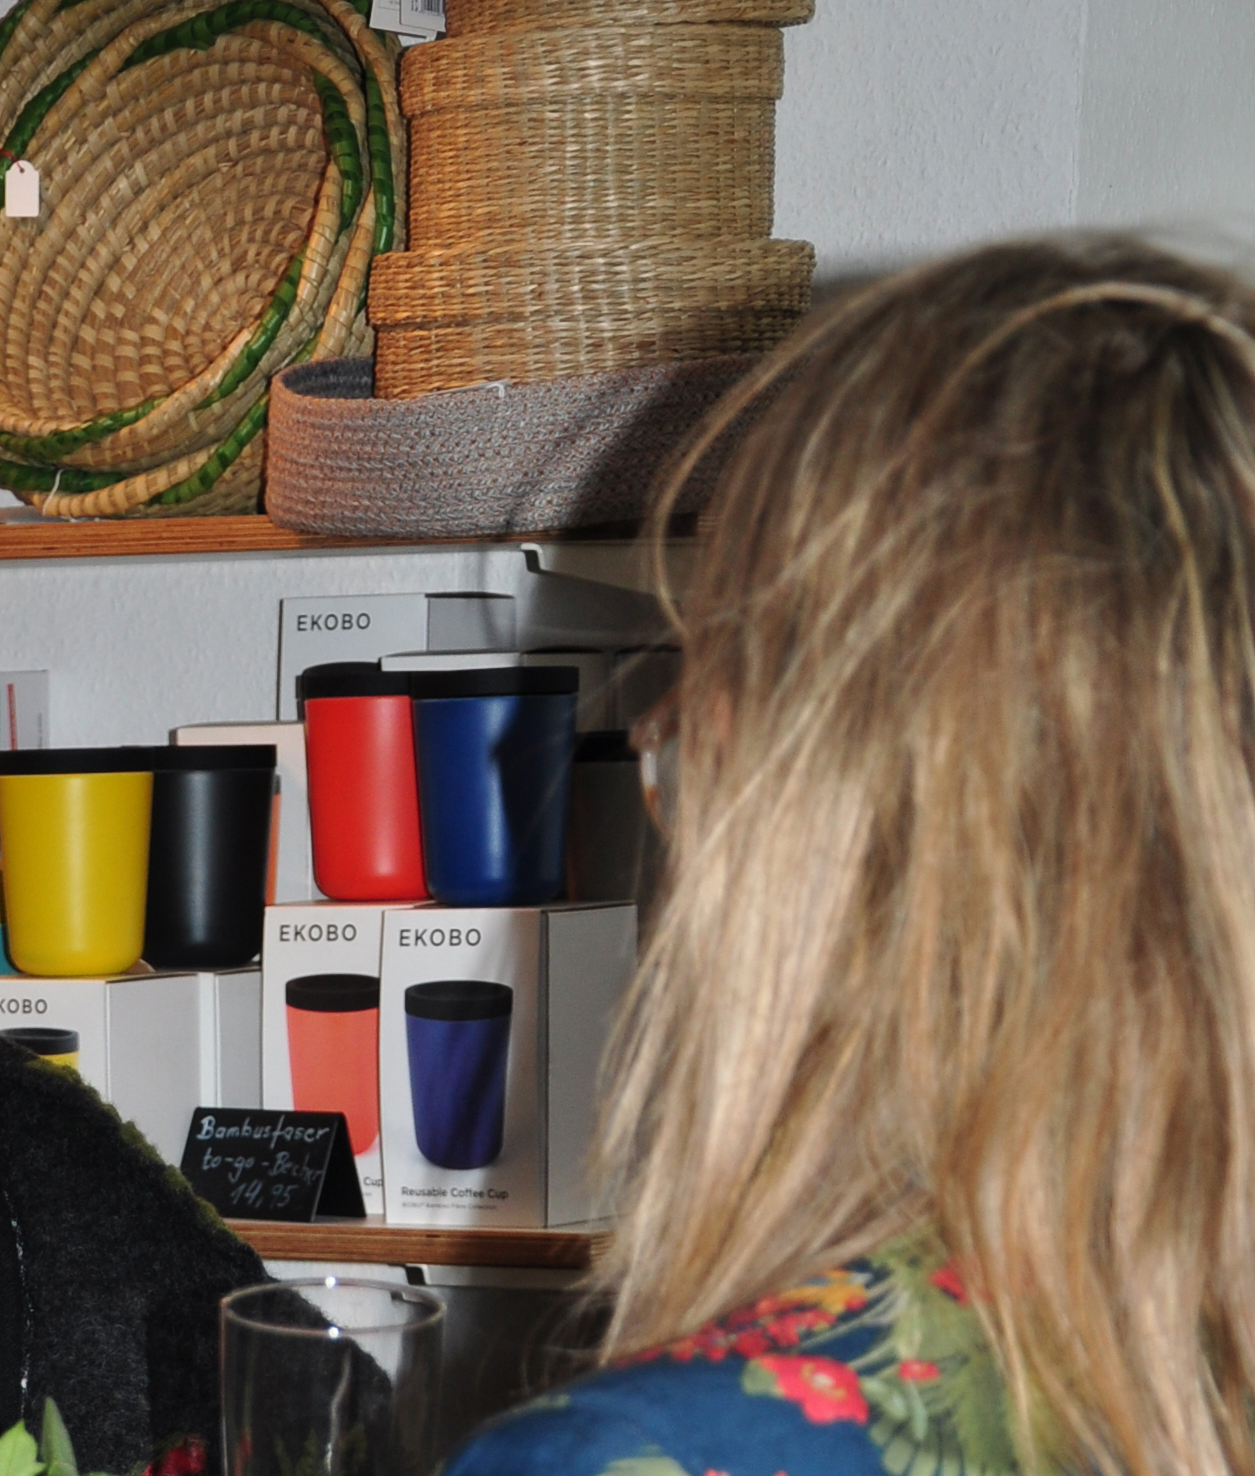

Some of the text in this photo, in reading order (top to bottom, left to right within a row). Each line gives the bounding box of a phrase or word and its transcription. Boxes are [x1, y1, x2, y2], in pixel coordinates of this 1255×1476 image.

[296, 613, 371, 631] EKOBO
[279, 923, 357, 942] EKOBO
[399, 927, 482, 947] EKOBO
[197, 1115, 330, 1149] Bambusfaser
[401, 1186, 509, 1201] Reusable Coffee Cup
